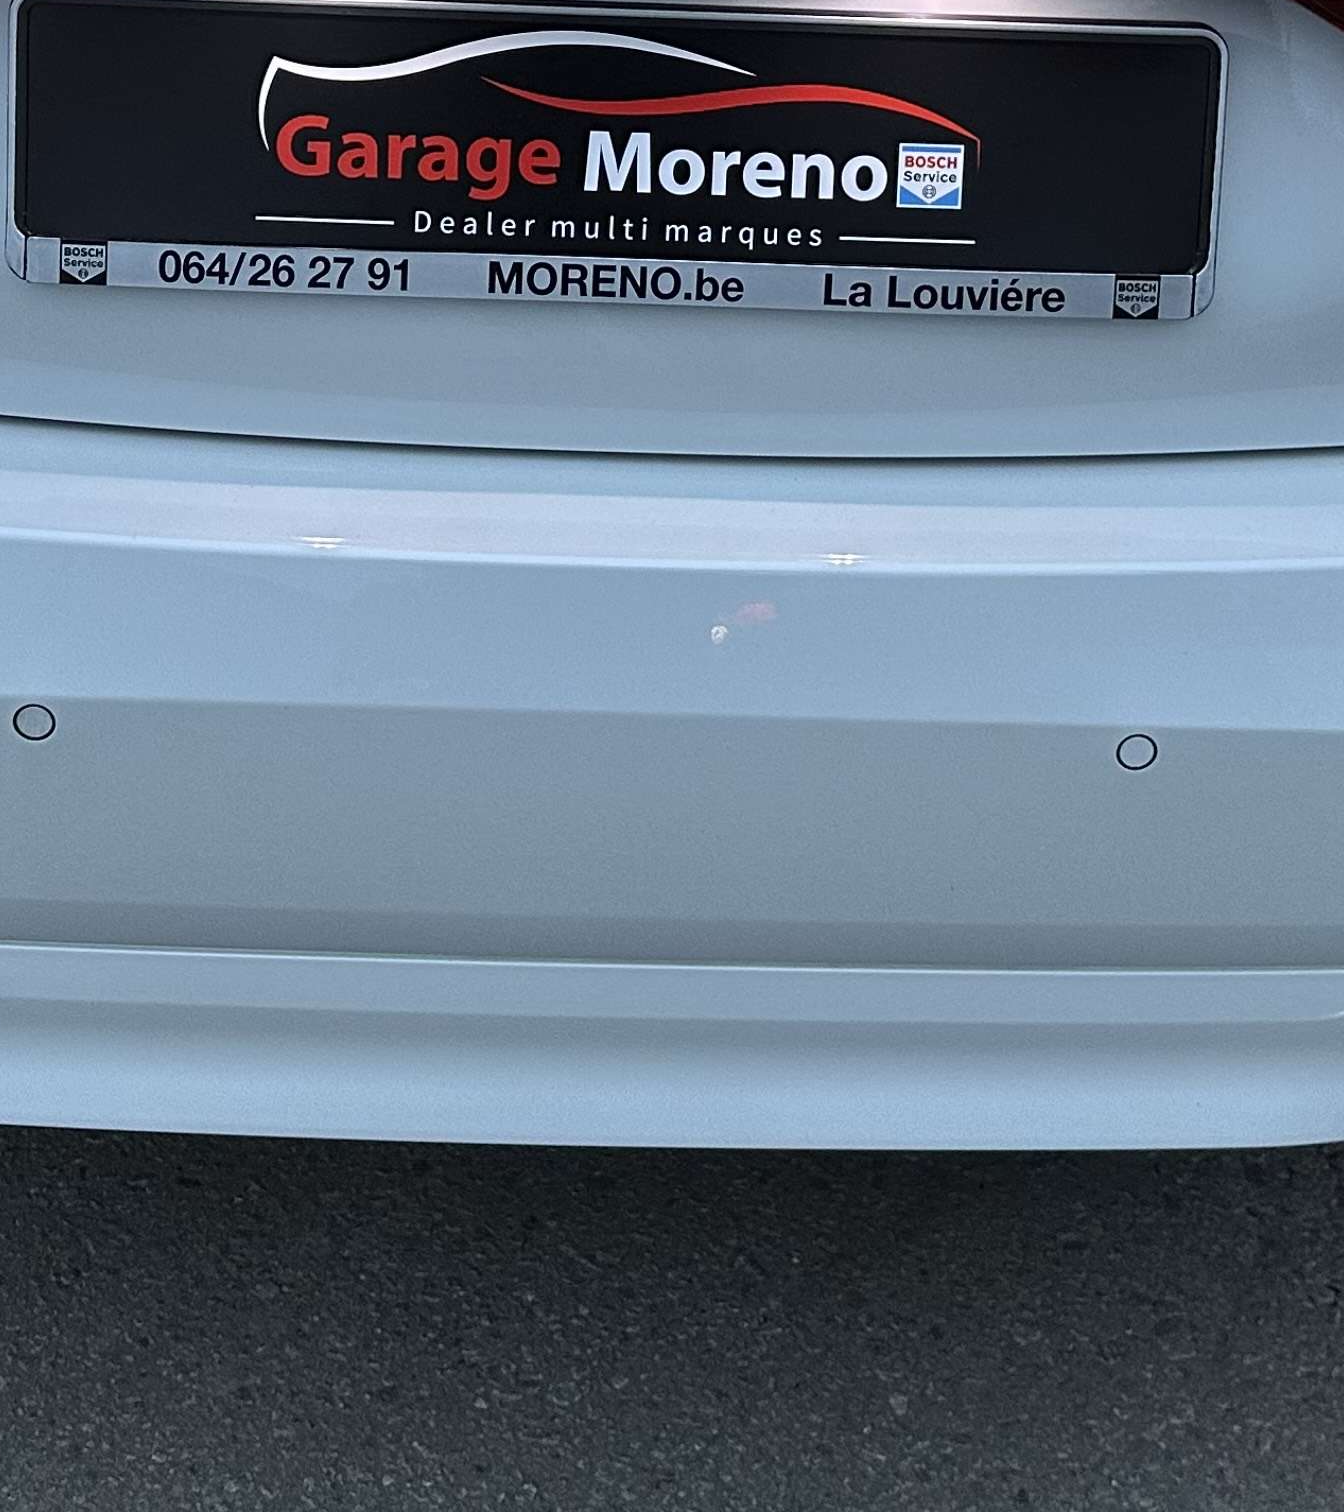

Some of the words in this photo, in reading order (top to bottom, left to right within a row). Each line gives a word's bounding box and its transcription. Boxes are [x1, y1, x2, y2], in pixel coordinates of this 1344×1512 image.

[275, 114, 561, 201] Garage
[583, 130, 888, 202] Moreno
[904, 155, 957, 169] BOSCH
[903, 170, 957, 183] Service
[414, 210, 536, 237] Dealer
[551, 216, 648, 241] multi
[664, 223, 823, 250] marques
[63, 246, 104, 258] BOSCH
[63, 257, 104, 268] Service
[158, 250, 295, 287] 064/26
[307, 255, 355, 289] 27
[367, 258, 409, 291] 91
[487, 260, 745, 303] MORENO.be
[823, 273, 872, 307] La
[887, 275, 1066, 312] Louviére
[1118, 282, 1157, 293] BOSCH
